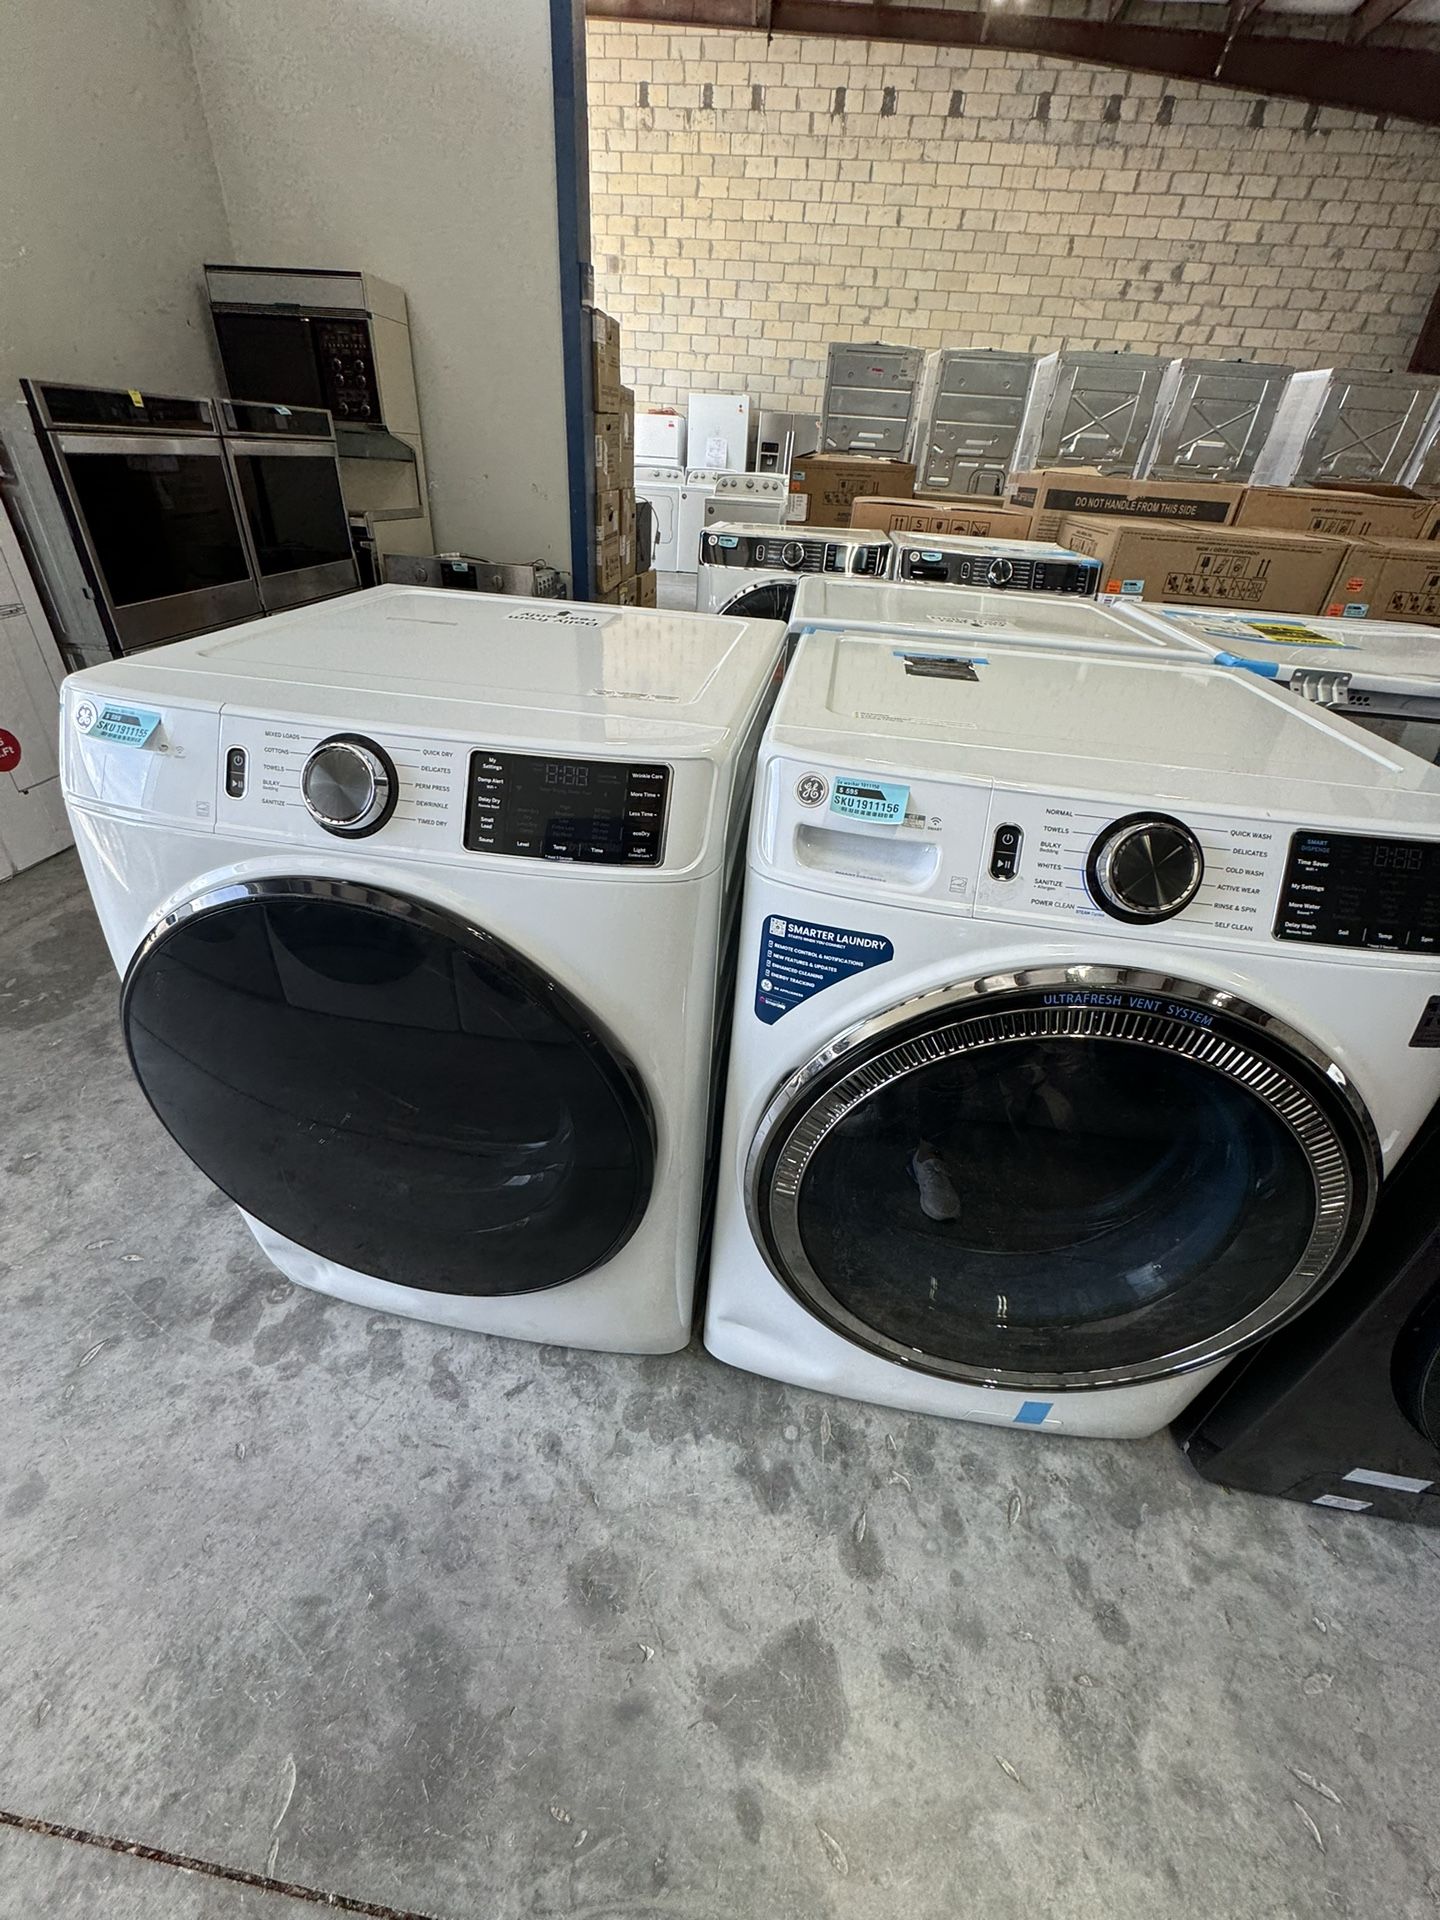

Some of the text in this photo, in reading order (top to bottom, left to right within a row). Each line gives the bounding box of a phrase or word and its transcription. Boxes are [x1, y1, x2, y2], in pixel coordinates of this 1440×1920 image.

[1075, 497, 1197, 515] DO NOT HANDLE FROM THIS SIDE
[265, 731, 280, 739] MIXED
[264, 747, 289, 755] COTTONS
[422, 749, 439, 758] QUICK
[488, 757, 497, 765] My
[263, 764, 284, 772] TOWELS
[420, 765, 452, 774] DELICATES
[482, 763, 503, 771] Settings
[632, 772, 652, 780] Wrinkle
[477, 777, 492, 785] Damp
[415, 782, 450, 793] PERM PRESS
[262, 798, 286, 807] SANITIZE
[416, 800, 449, 809] DEWRINKLE
[478, 796, 500, 806] Delay Dry
[834, 795, 900, 813] SKU1911156
[1045, 808, 1073, 817] NORMAL
[417, 818, 434, 826] TIMED
[1043, 825, 1070, 834] TOWELS
[1230, 829, 1272, 840] QUICK WASH
[478, 836, 494, 844] Sound
[1307, 838, 1329, 846] SMART
[553, 844, 567, 852] Temp
[1040, 842, 1061, 850] BULKY
[1301, 845, 1331, 854] DISPENSE
[1232, 848, 1268, 858] DELICATES
[1037, 862, 1062, 871] WHITES
[1297, 858, 1330, 868] Time Saver
[1225, 866, 1264, 877] COLD WASH
[1034, 878, 1063, 888] SANITIZE
[1291, 883, 1325, 892] My Settings
[1217, 884, 1260, 895] ACTIVE WEAR
[1031, 898, 1075, 910] POWER CLEAN
[1214, 902, 1233, 911] RINSE
[1240, 905, 1257, 913] SPIN
[1288, 901, 1321, 910] More Water
[1214, 921, 1253, 932] SELF CLEAN
[1284, 921, 1317, 930] Delay Wash
[788, 923, 887, 950] SMARTER LAUNDRY
[1378, 932, 1392, 940] Temp
[825, 941, 846, 949] CONNECT
[774, 942, 794, 952] REMOTE
[794, 947, 818, 958] CONTROL
[824, 954, 864, 967] NOTIFICATIONS
[773, 952, 784, 960] NEW
[785, 955, 808, 966] FEATURES
[814, 963, 838, 972] UPDATES
[772, 962, 824, 980] ENHANCED CLEANING
[770, 971, 815, 988] ENERGY TRACKING
[1044, 993, 1214, 1026] ULTRAFRESH VENT SYSTEM
